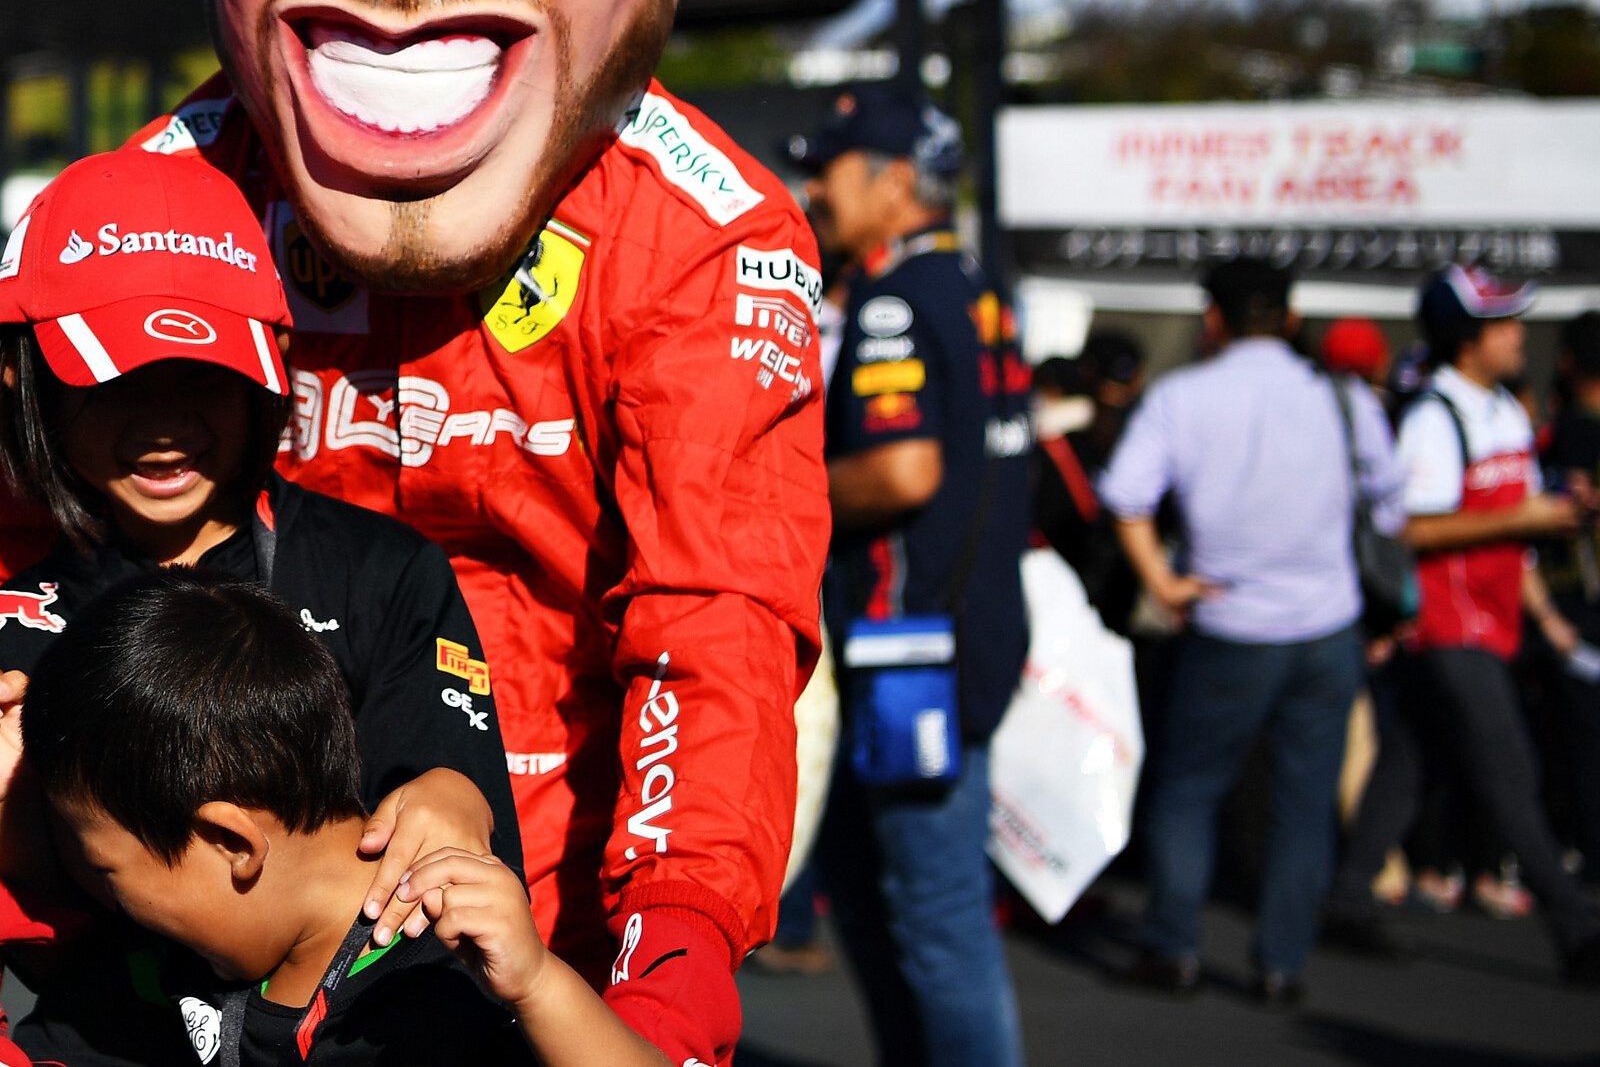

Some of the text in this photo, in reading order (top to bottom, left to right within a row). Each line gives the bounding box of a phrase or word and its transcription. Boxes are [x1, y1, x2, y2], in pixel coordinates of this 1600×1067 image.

[624, 106, 735, 193] ASPERSKY
[97, 223, 257, 273] Santander
[742, 257, 822, 314] HUBLO
